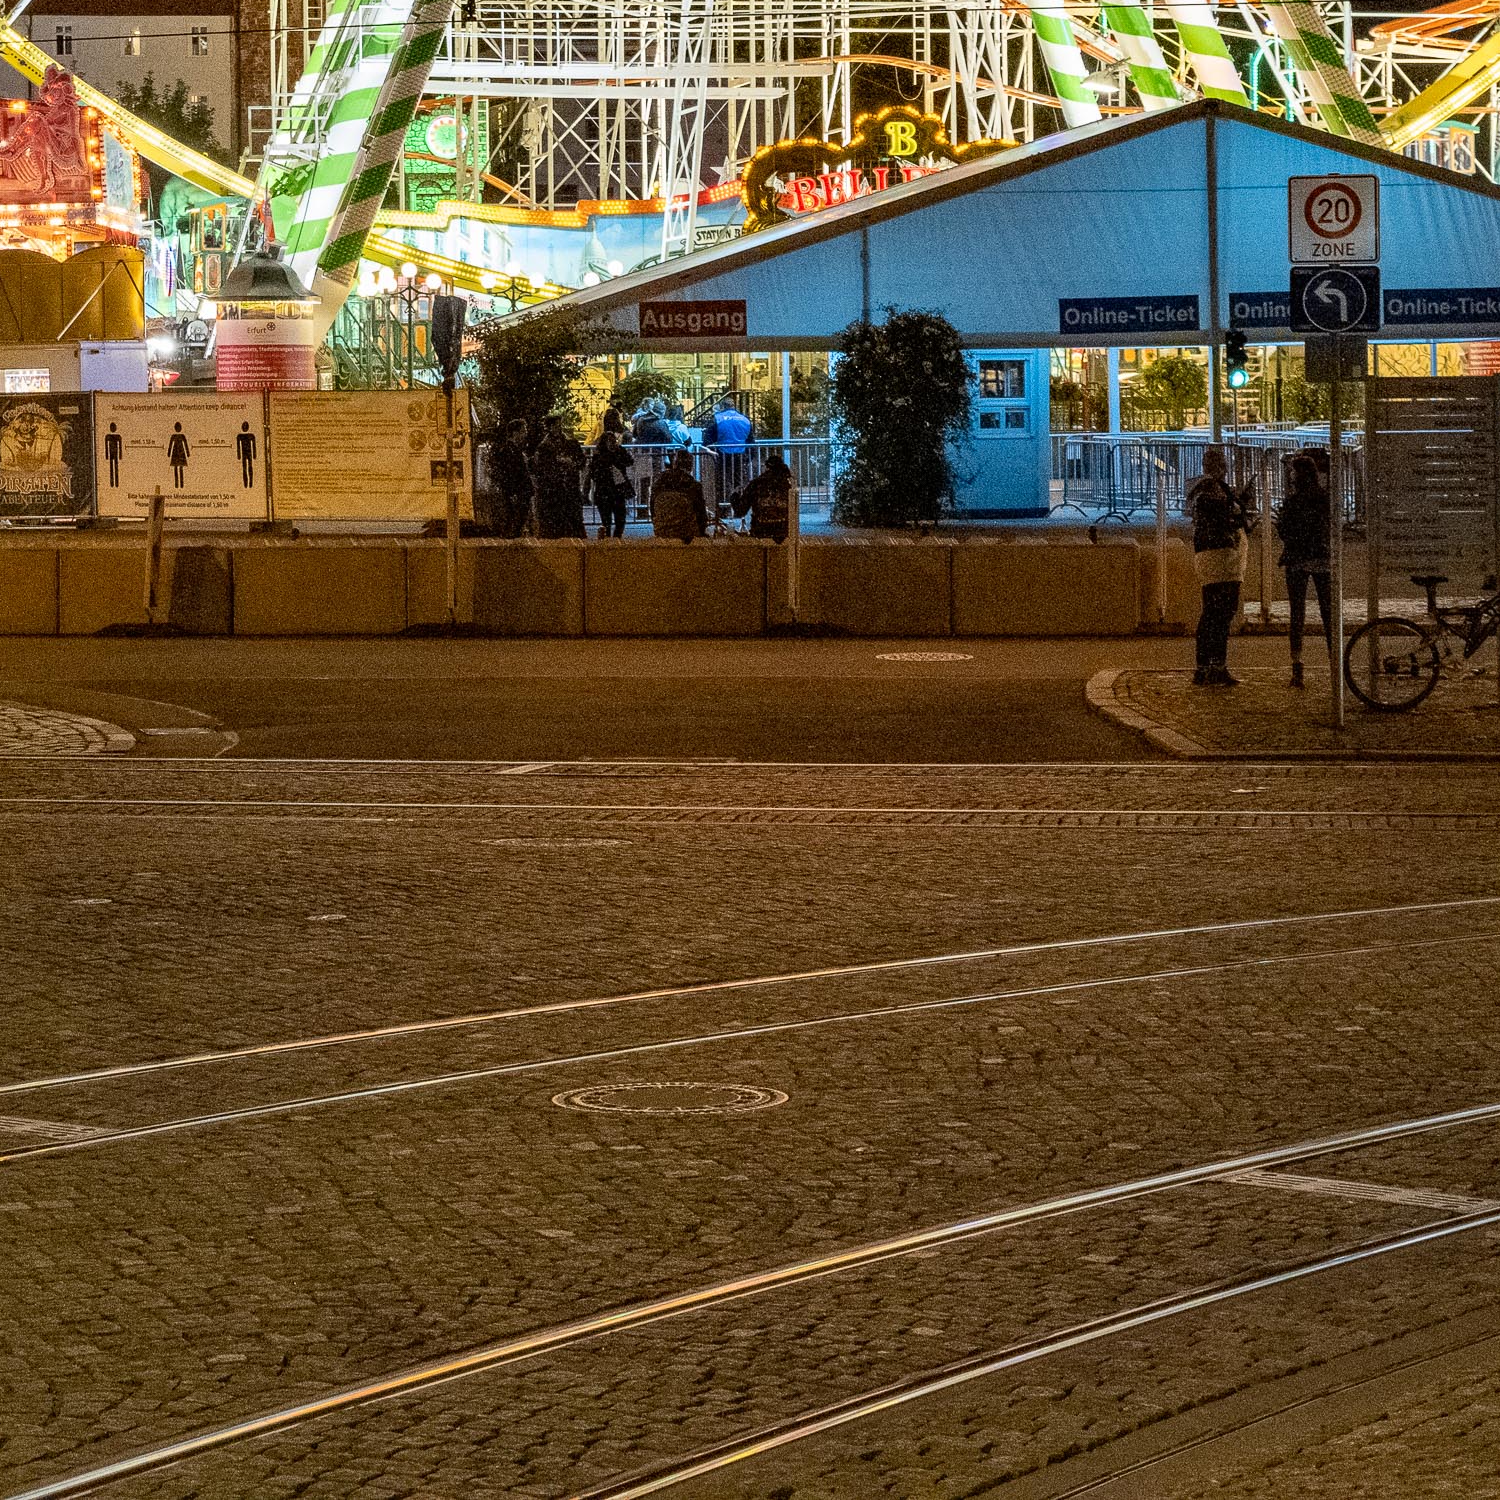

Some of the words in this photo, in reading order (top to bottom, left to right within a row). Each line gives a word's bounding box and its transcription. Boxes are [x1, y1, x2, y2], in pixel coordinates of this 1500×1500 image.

[885, 121, 918, 156] B
[1317, 197, 1350, 224] 20
[1312, 242, 1355, 257] ZONE
[641, 307, 746, 334] Ausgang
[1064, 304, 1197, 326] Online-Ticket
[247, 326, 267, 335] Erfurt
[1, 495, 66, 506] ABENTEUER
